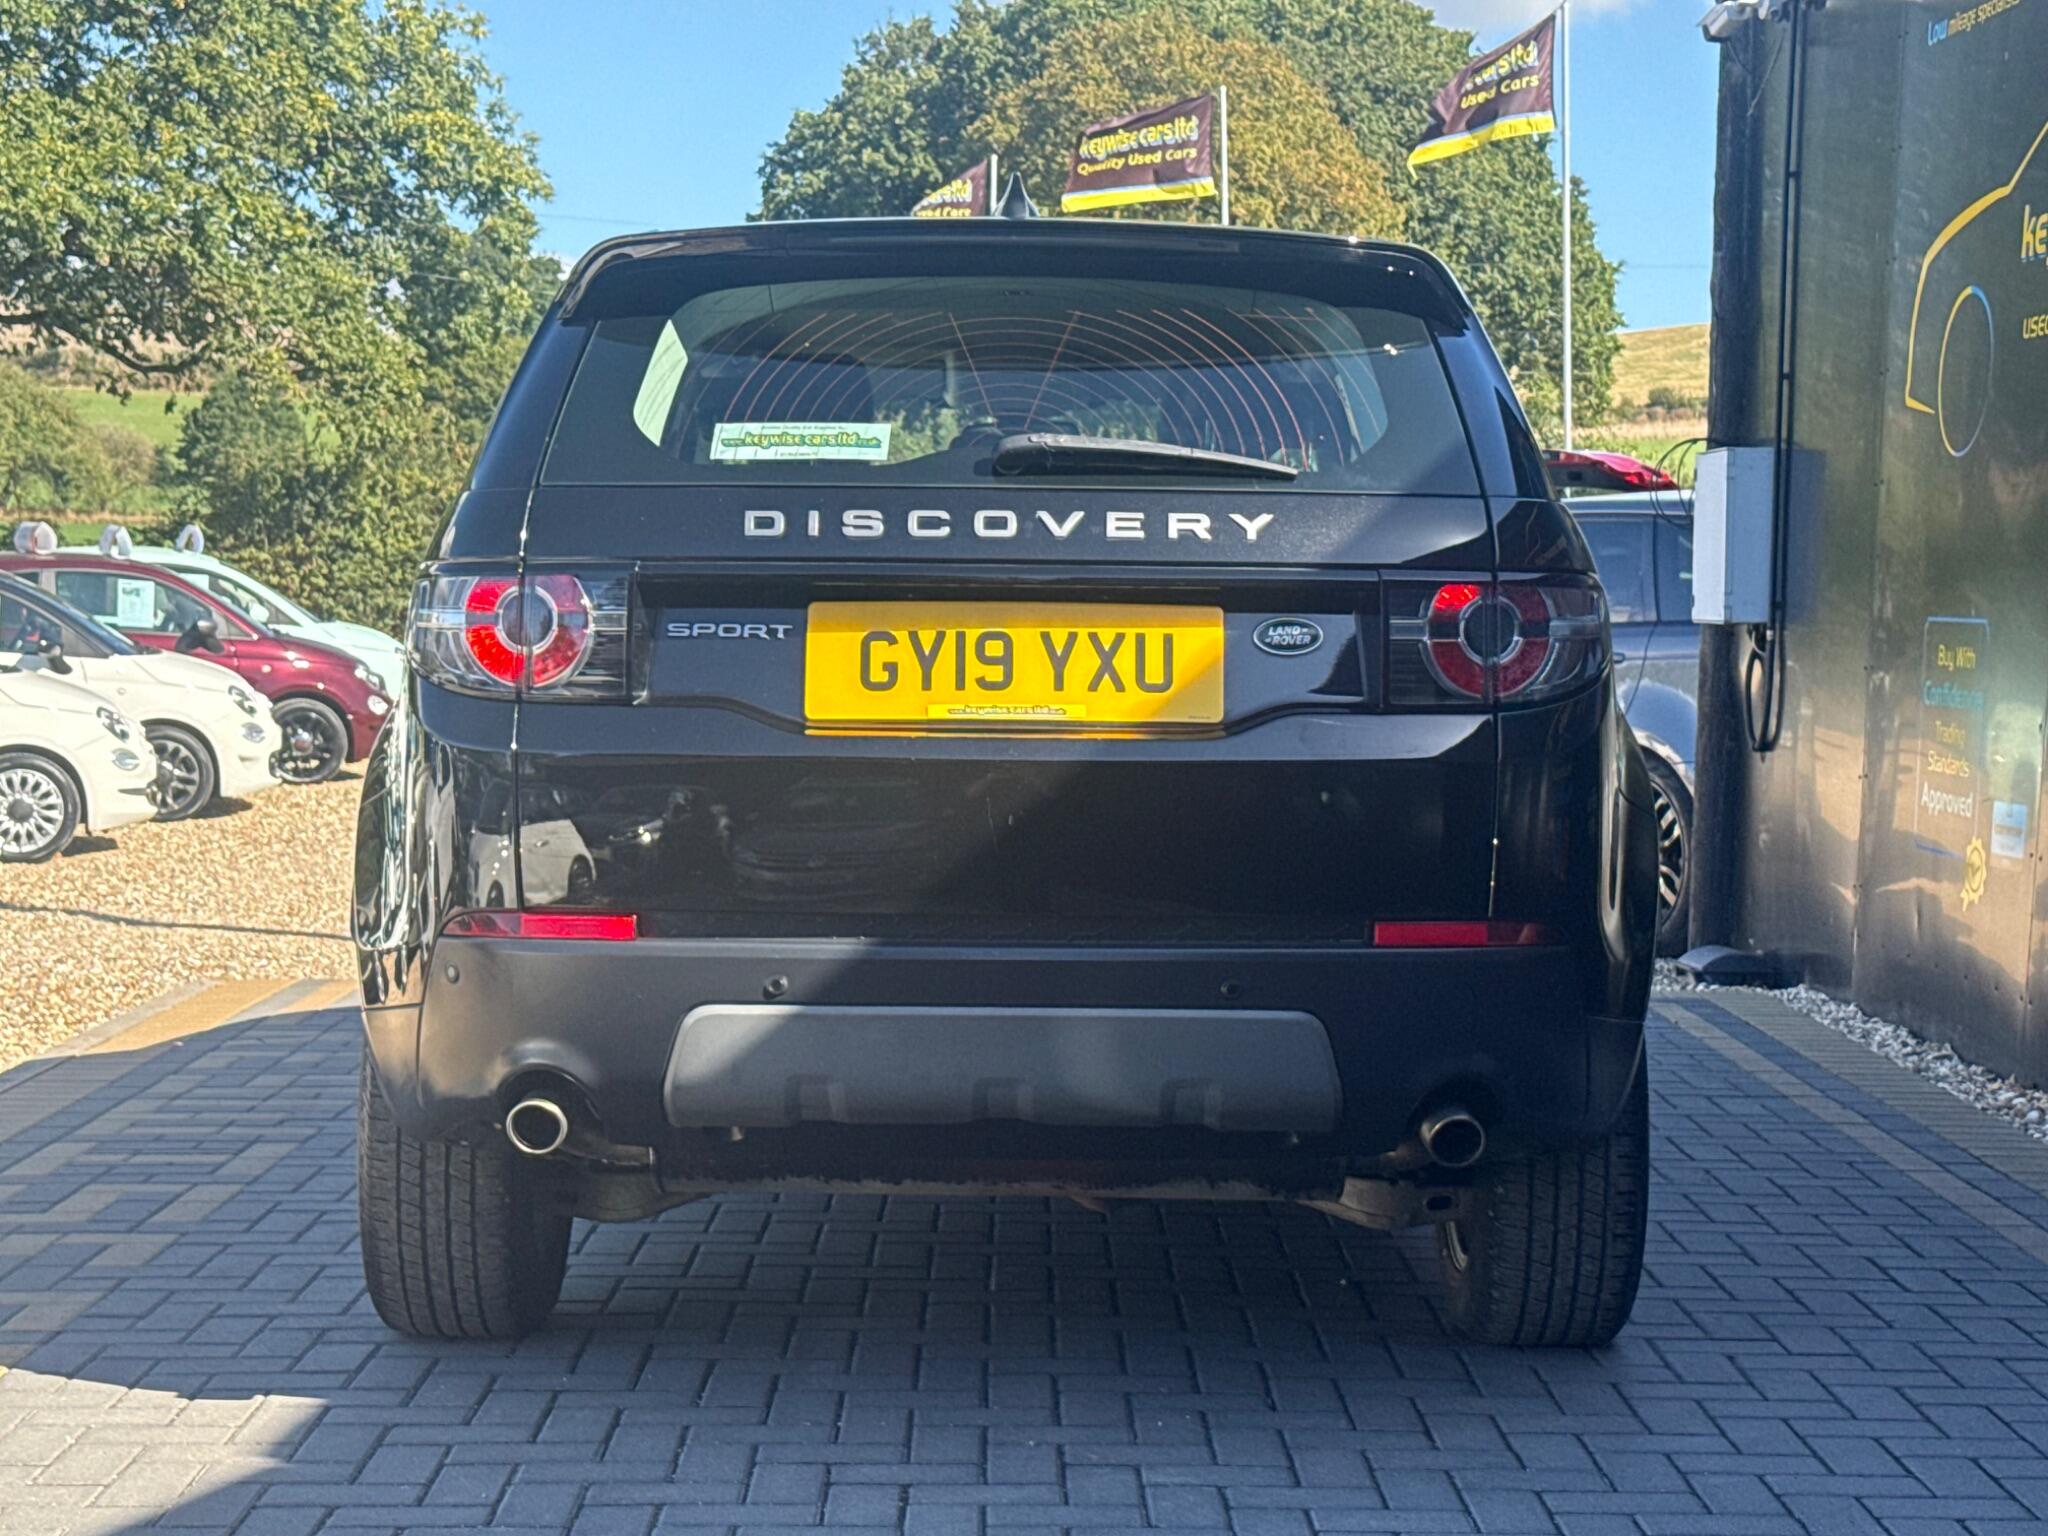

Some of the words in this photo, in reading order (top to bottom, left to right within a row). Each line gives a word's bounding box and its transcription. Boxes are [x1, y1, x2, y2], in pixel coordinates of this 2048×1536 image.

[1928, 19, 1948, 46] Low
[1460, 87, 1496, 109] Used
[1501, 74, 1540, 94] Cars
[1077, 157, 1125, 176] Quality
[1128, 150, 1162, 166] Used
[1165, 147, 1198, 161] Cars
[743, 509, 1275, 541] DISCOVERY
[666, 622, 792, 640] SPORT
[859, 629, 1011, 692] GY19
[1039, 630, 1174, 692] YXU
[1937, 643, 1954, 672] Buy
[1955, 645, 1977, 669] With
[1935, 721, 1966, 747] Trading
[1927, 750, 1971, 777] Standards
[1921, 781, 1974, 817] Approved
